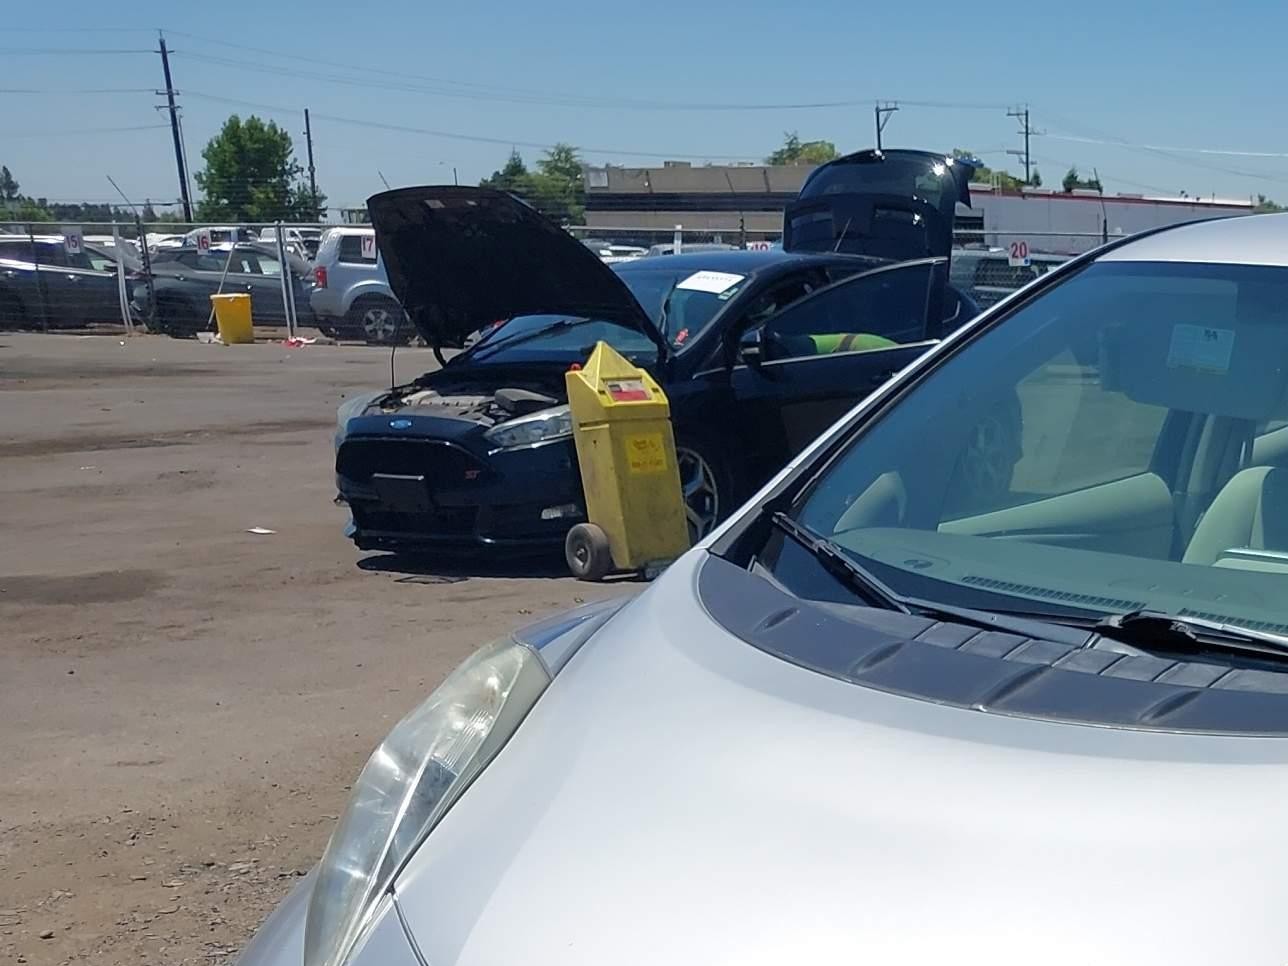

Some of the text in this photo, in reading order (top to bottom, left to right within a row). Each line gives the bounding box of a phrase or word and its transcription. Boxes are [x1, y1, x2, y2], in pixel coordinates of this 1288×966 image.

[196, 235, 208, 249] 16
[362, 238, 373, 252] 17
[1010, 241, 1028, 258] 20
